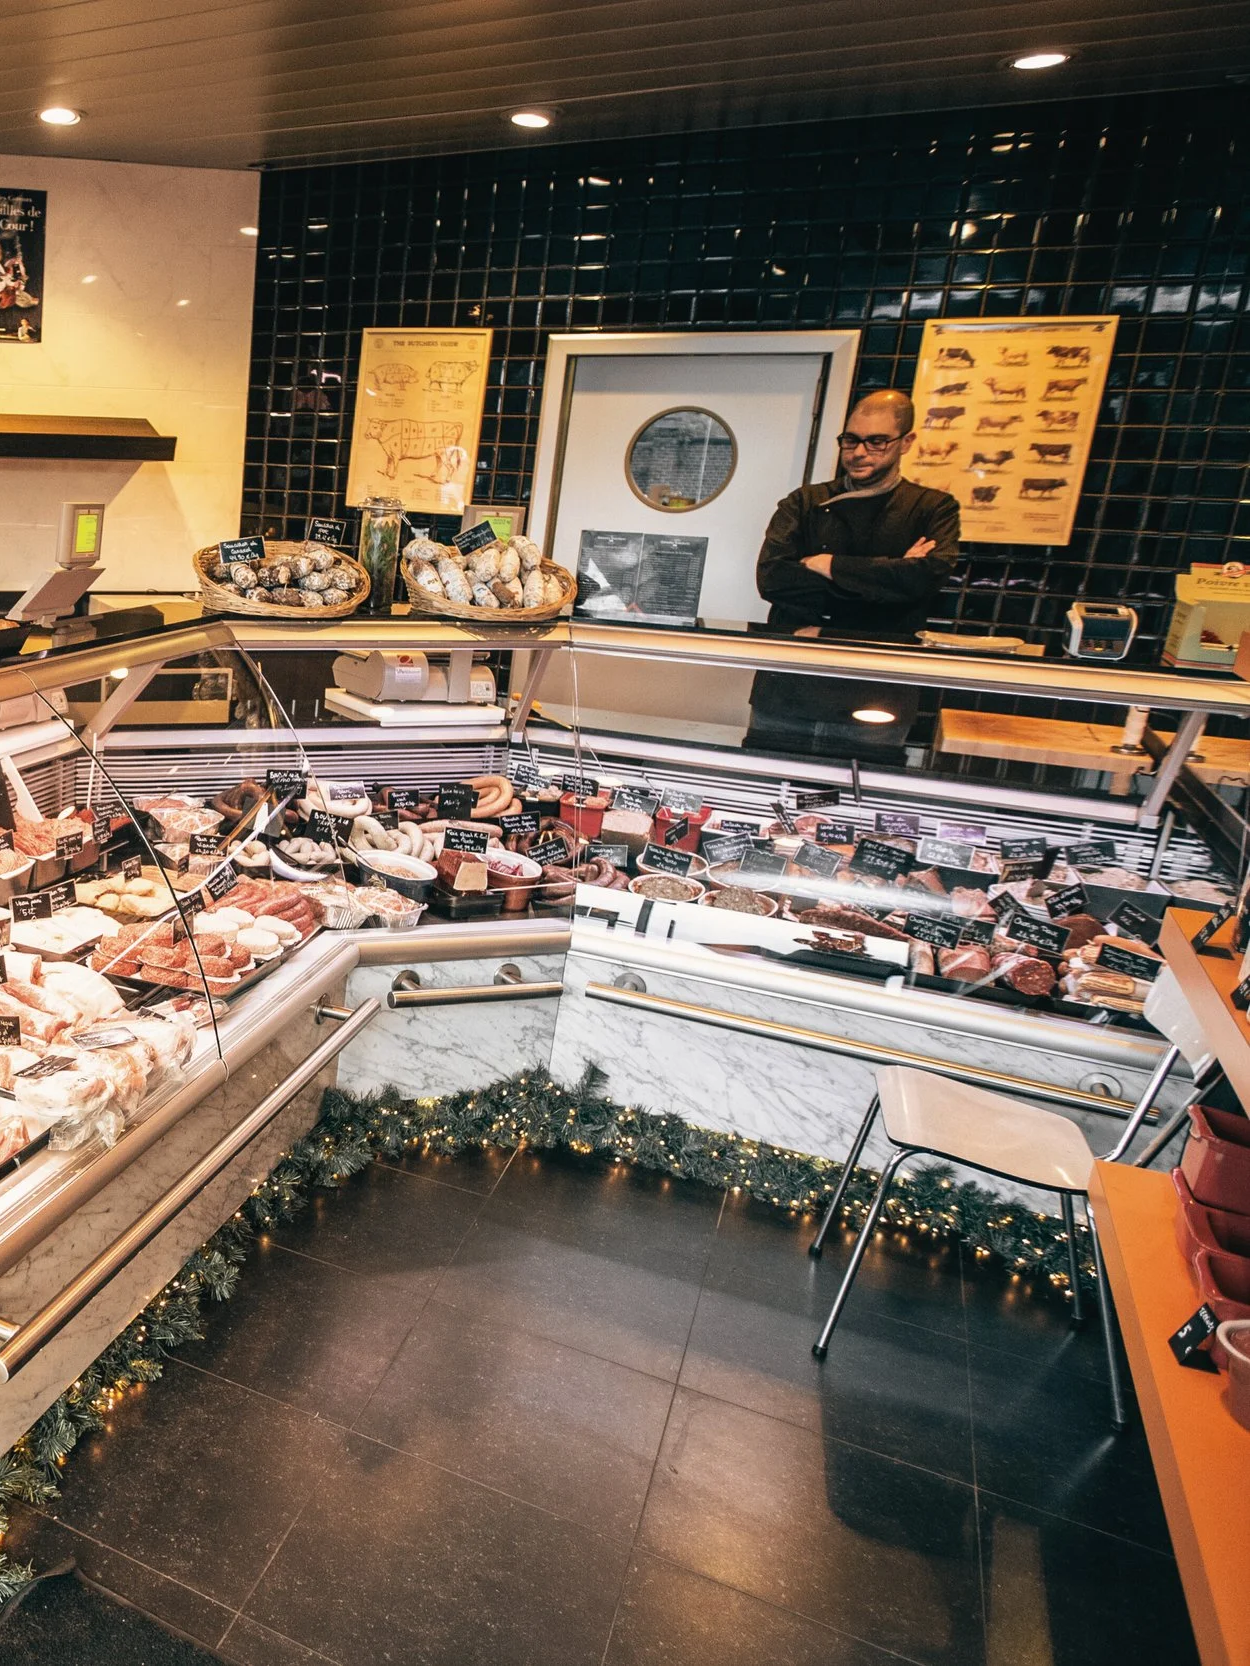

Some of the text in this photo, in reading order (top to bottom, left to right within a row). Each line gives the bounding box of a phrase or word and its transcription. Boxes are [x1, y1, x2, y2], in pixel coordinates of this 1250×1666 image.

[27, 206, 42, 218] de
[0, 219, 29, 231] Cour
[1196, 577, 1240, 588] Poivre
[1177, 1323, 1192, 1339] 5
